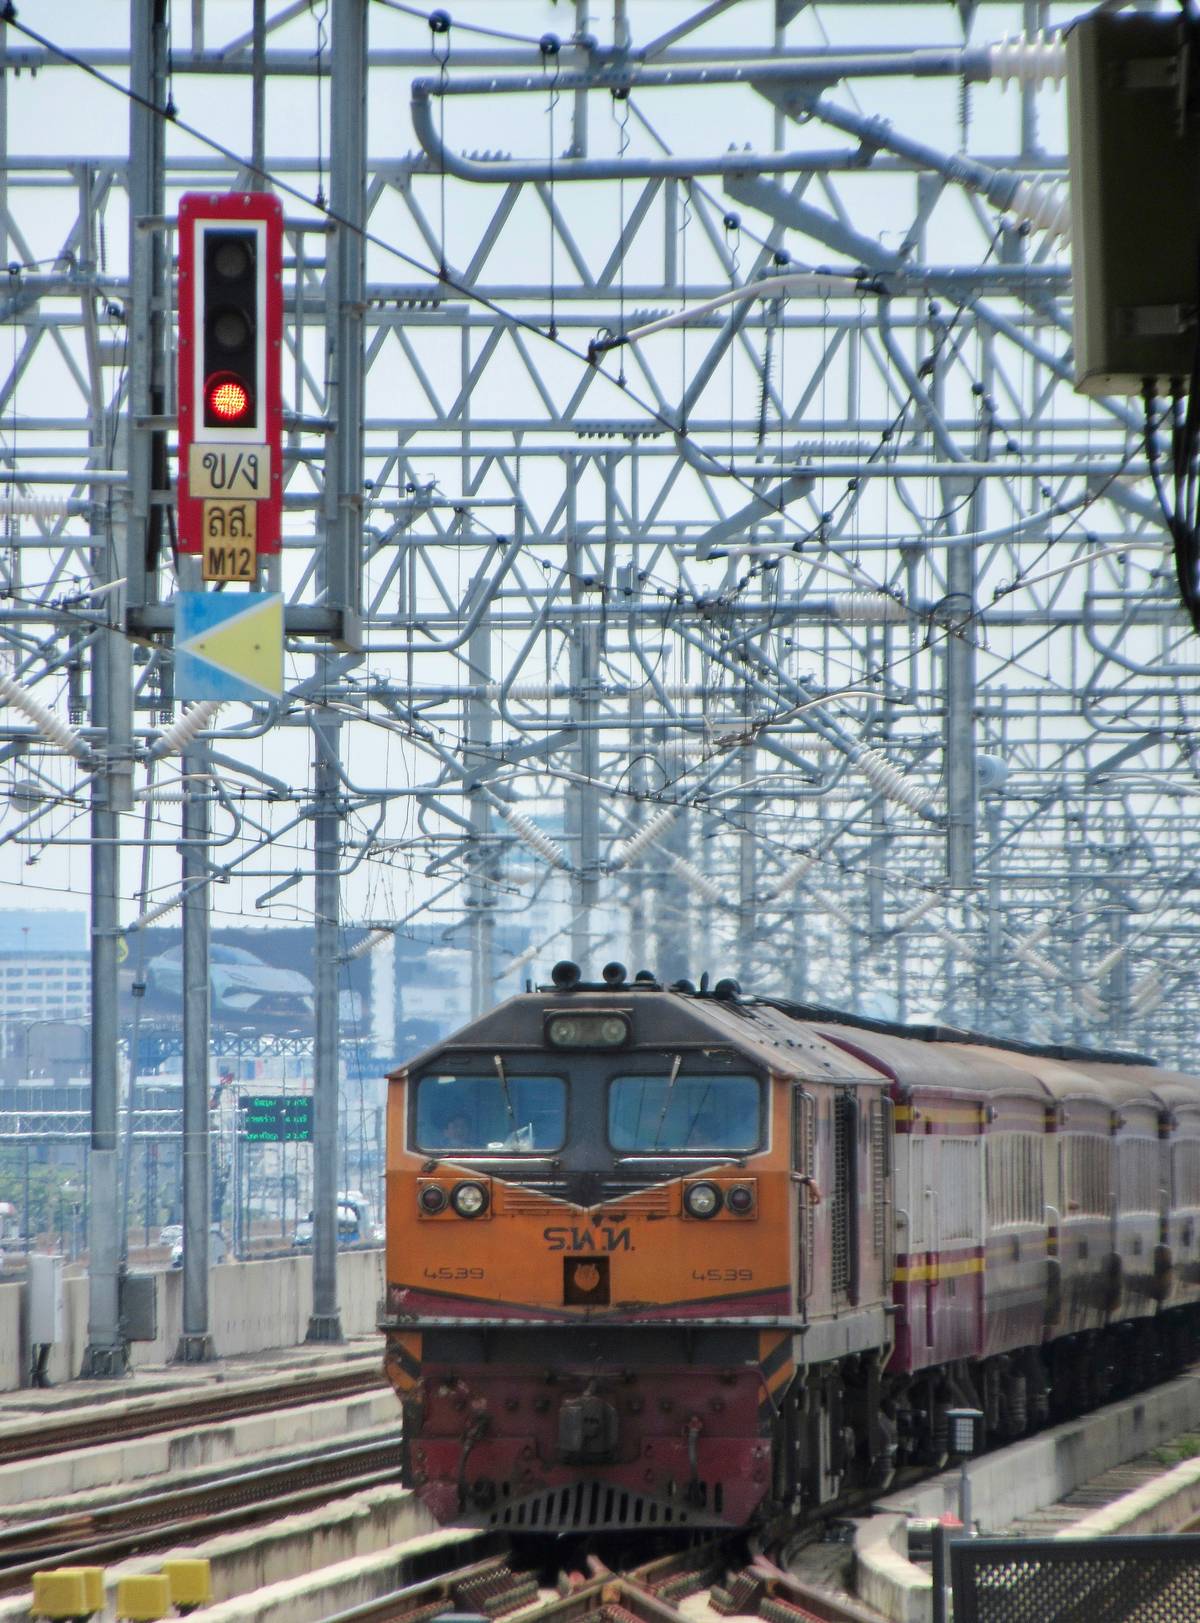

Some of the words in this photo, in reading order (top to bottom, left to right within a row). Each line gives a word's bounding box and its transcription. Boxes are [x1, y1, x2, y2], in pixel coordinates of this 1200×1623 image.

[208, 547, 251, 576] M12
[424, 1267, 484, 1280] 4539
[692, 1268, 753, 1281] 4539
